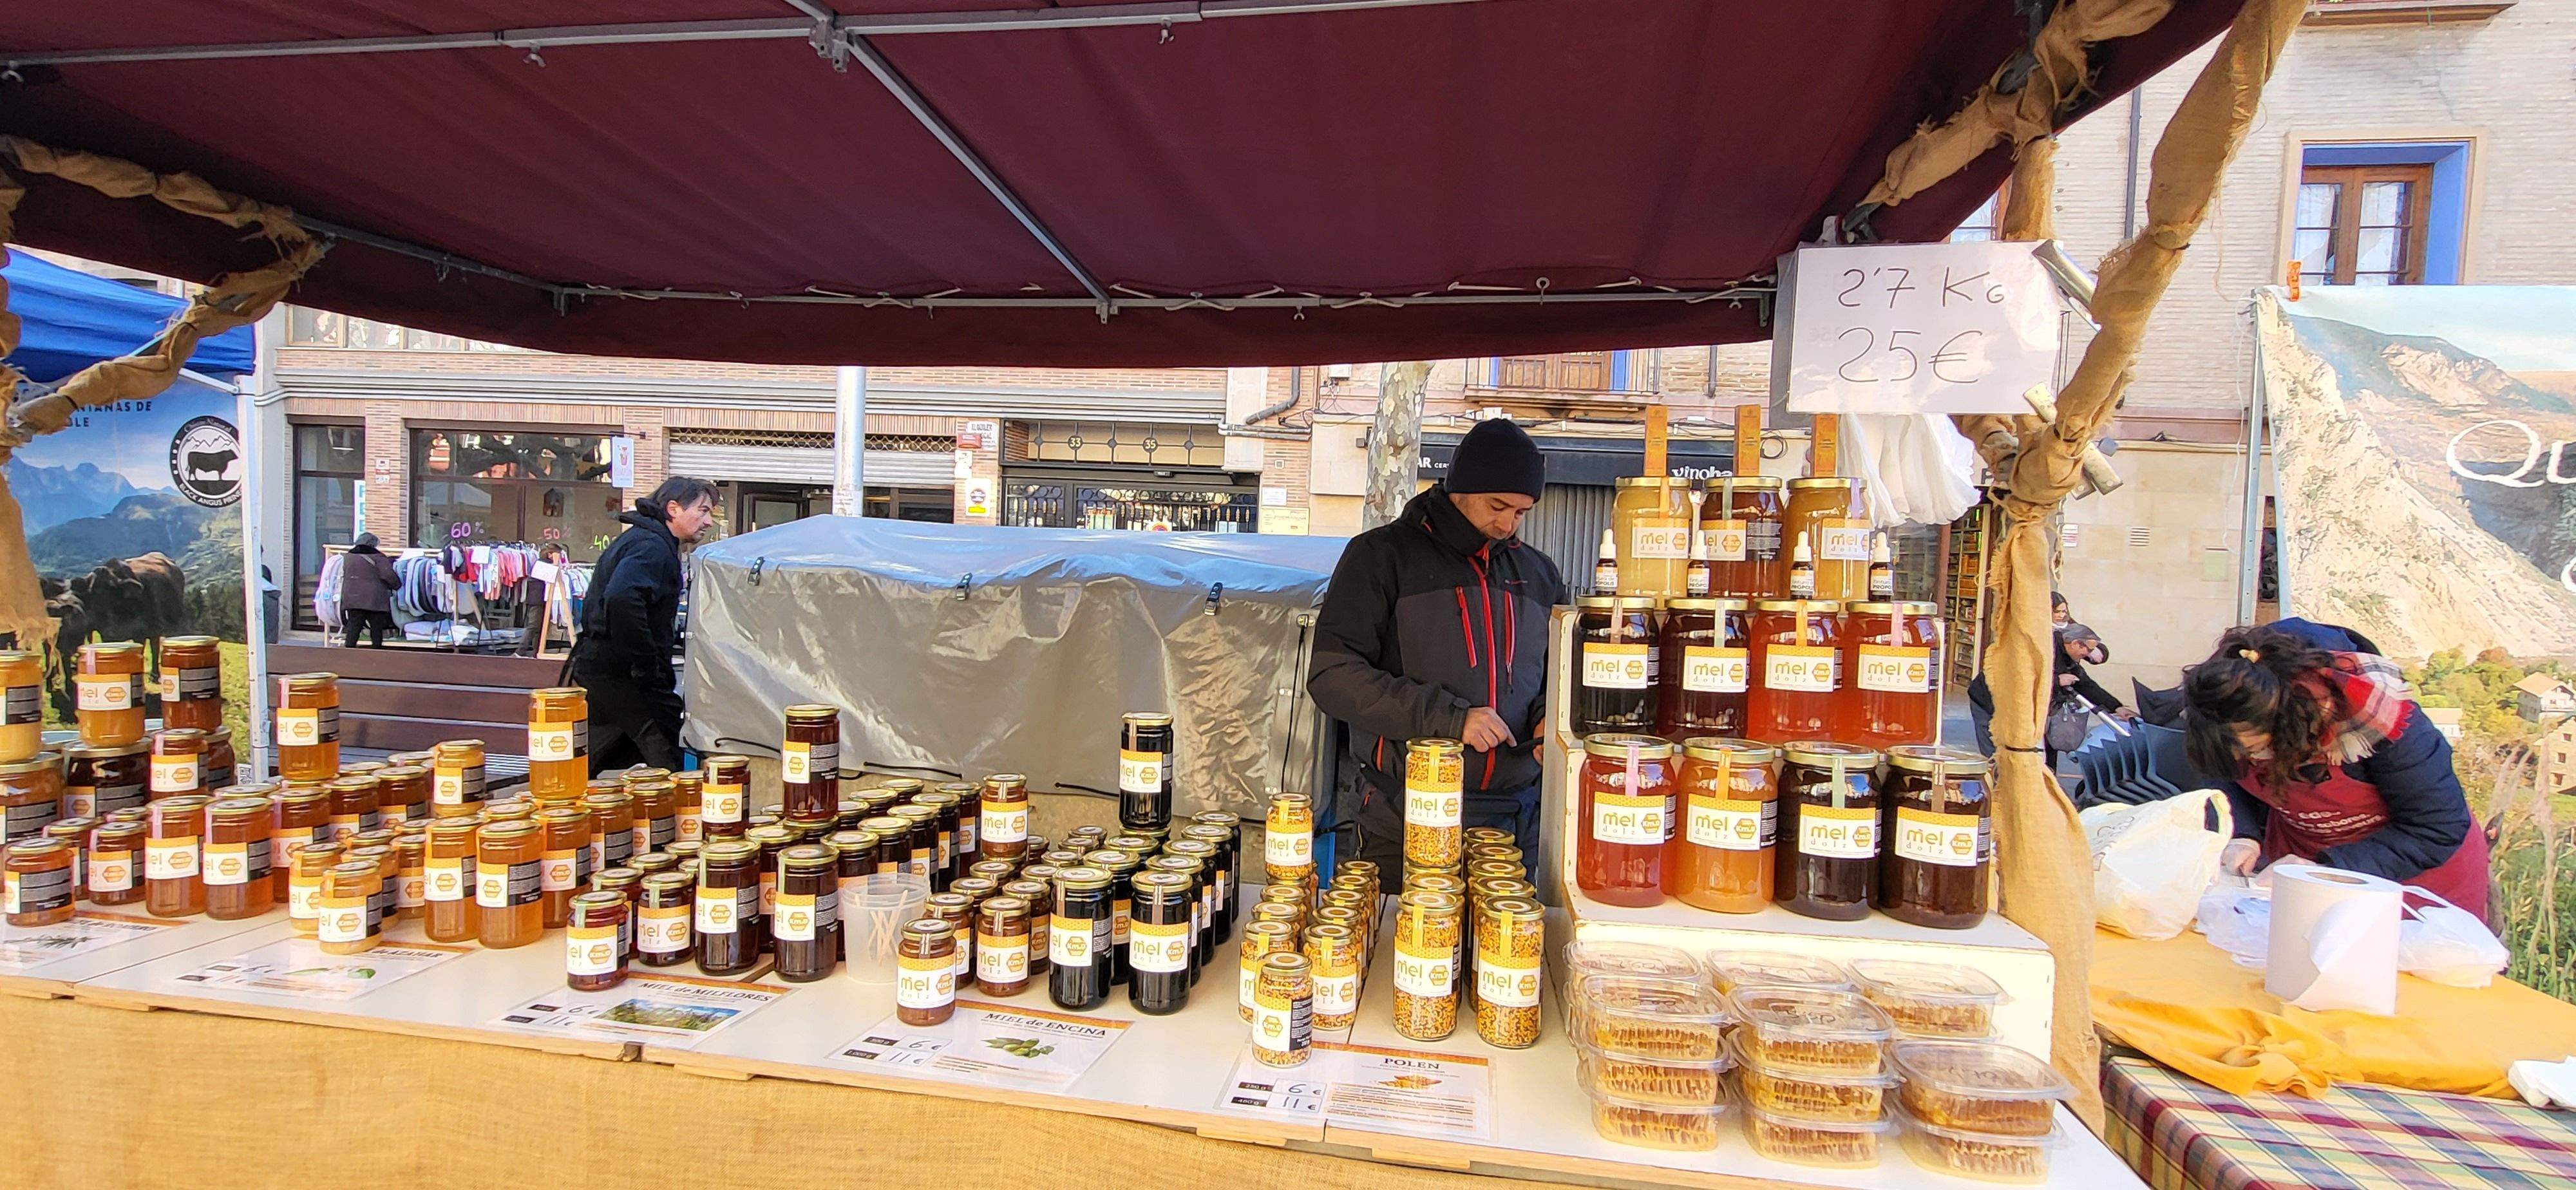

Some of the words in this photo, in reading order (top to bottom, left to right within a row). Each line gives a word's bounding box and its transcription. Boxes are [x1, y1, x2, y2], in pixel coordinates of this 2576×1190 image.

[1838, 327, 1982, 384] 25€
[137, 401, 152, 411] DE
[1070, 438, 1081, 447] 33
[1145, 440, 1156, 449] 35
[1641, 533, 1667, 543] mel
[1832, 534, 1857, 545] mel
[1591, 660, 1619, 672] mel
[1694, 663, 1723, 675] mel
[1776, 663, 1806, 675] mel
[1868, 663, 1900, 675] mel
[1411, 798, 1437, 811] mel
[984, 817, 1006, 829] mel
[1604, 812, 1635, 827] mel
[1696, 815, 1728, 830] mel
[1603, 826, 1635, 835] dolz
[1696, 829, 1727, 839] dolz
[1811, 825, 1846, 840] mel
[1811, 838, 1846, 848] dolz
[1907, 829, 1943, 845] mel
[1267, 838, 1288, 850] mel
[1906, 843, 1943, 854] dolz
[1134, 941, 1159, 954] mel
[1429, 971, 1449, 979] Km.0
[1484, 971, 1511, 988] mel
[901, 976, 929, 990] mel
[692, 988, 773, 1002] MILFLORES
[985, 1013, 1023, 1024] MIEL
[1045, 1022, 1106, 1036] ENCINA
[909, 1040, 931, 1048] 6
[1385, 1058, 1440, 1070] POLEN
[1289, 1084, 1307, 1093] 6
[1283, 1096, 1300, 1108] 11
